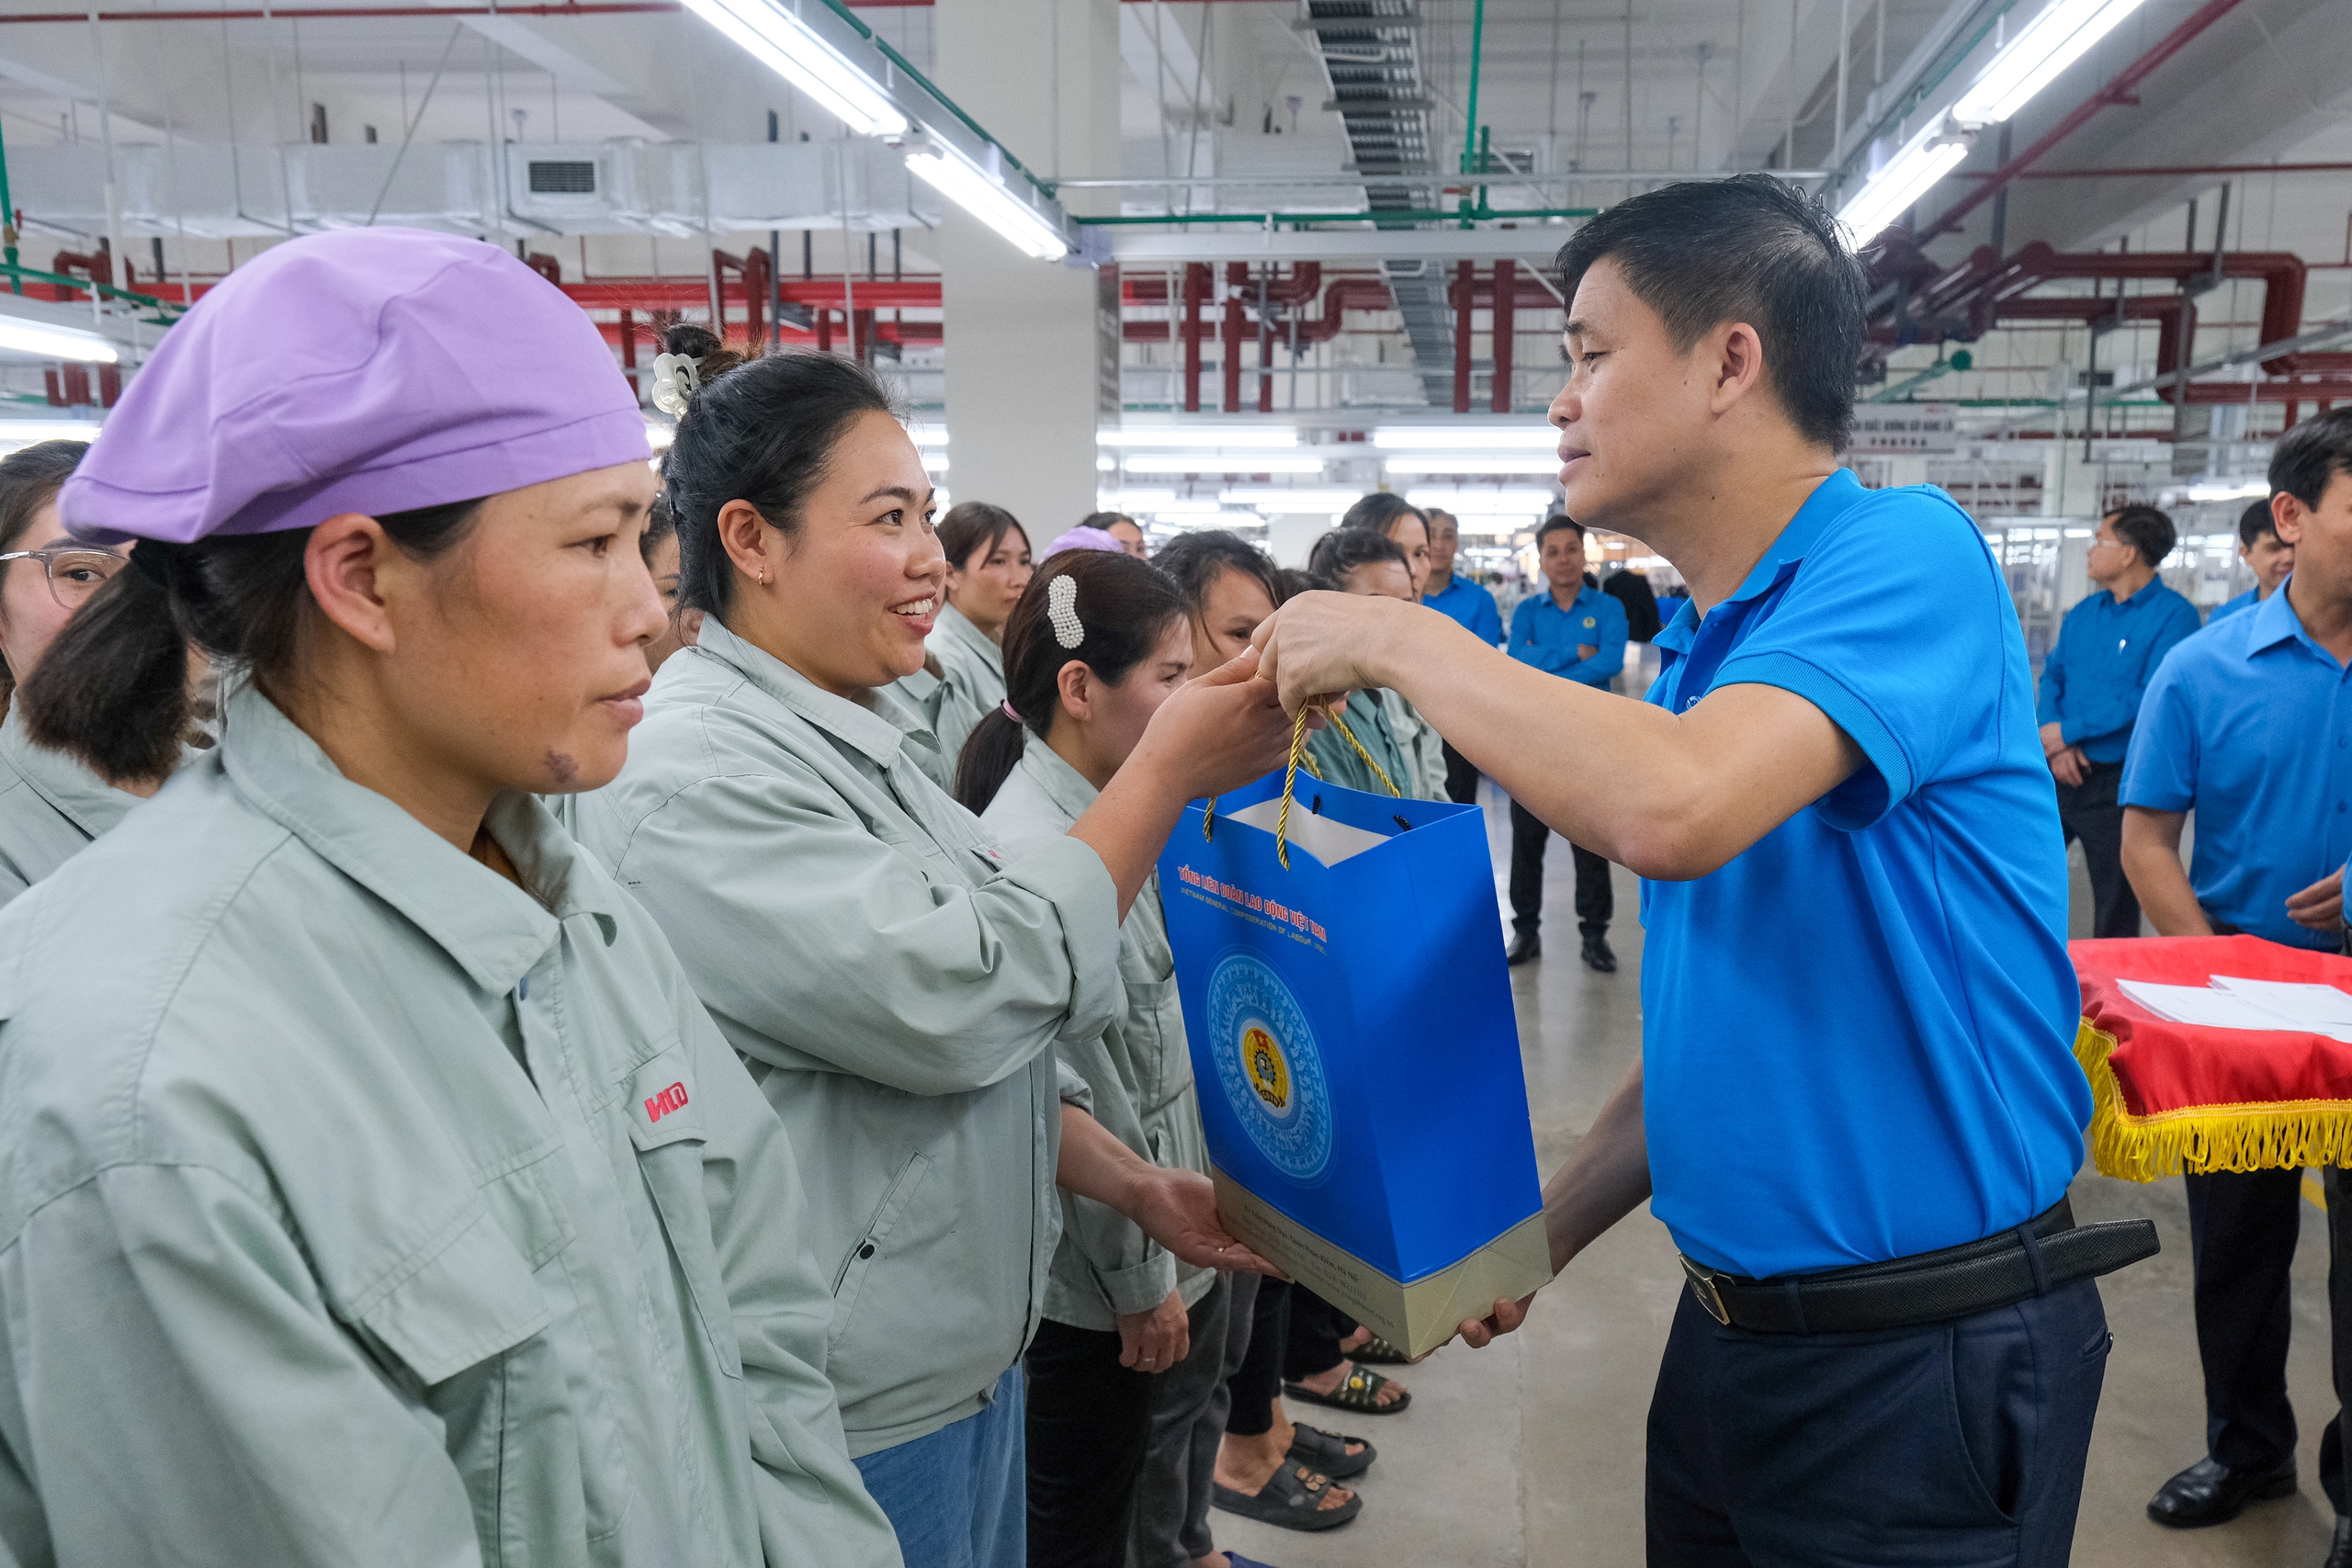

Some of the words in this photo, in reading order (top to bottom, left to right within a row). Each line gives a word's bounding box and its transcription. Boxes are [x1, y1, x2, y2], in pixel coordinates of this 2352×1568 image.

[1178, 863, 1201, 887] TỔNG
[1201, 874, 1219, 895] LIÊN
[1220, 883, 1244, 905] ĐOÀN
[1245, 892, 1262, 911] LAO
[1263, 898, 1289, 922] ĐỘNG
[1289, 909, 1309, 931] VIỆT
[1309, 919, 1328, 943] NAM
[1181, 886, 1204, 902] VIETNAM
[1278, 925, 1286, 935] OF
[1287, 931, 1312, 946] LABOUR
